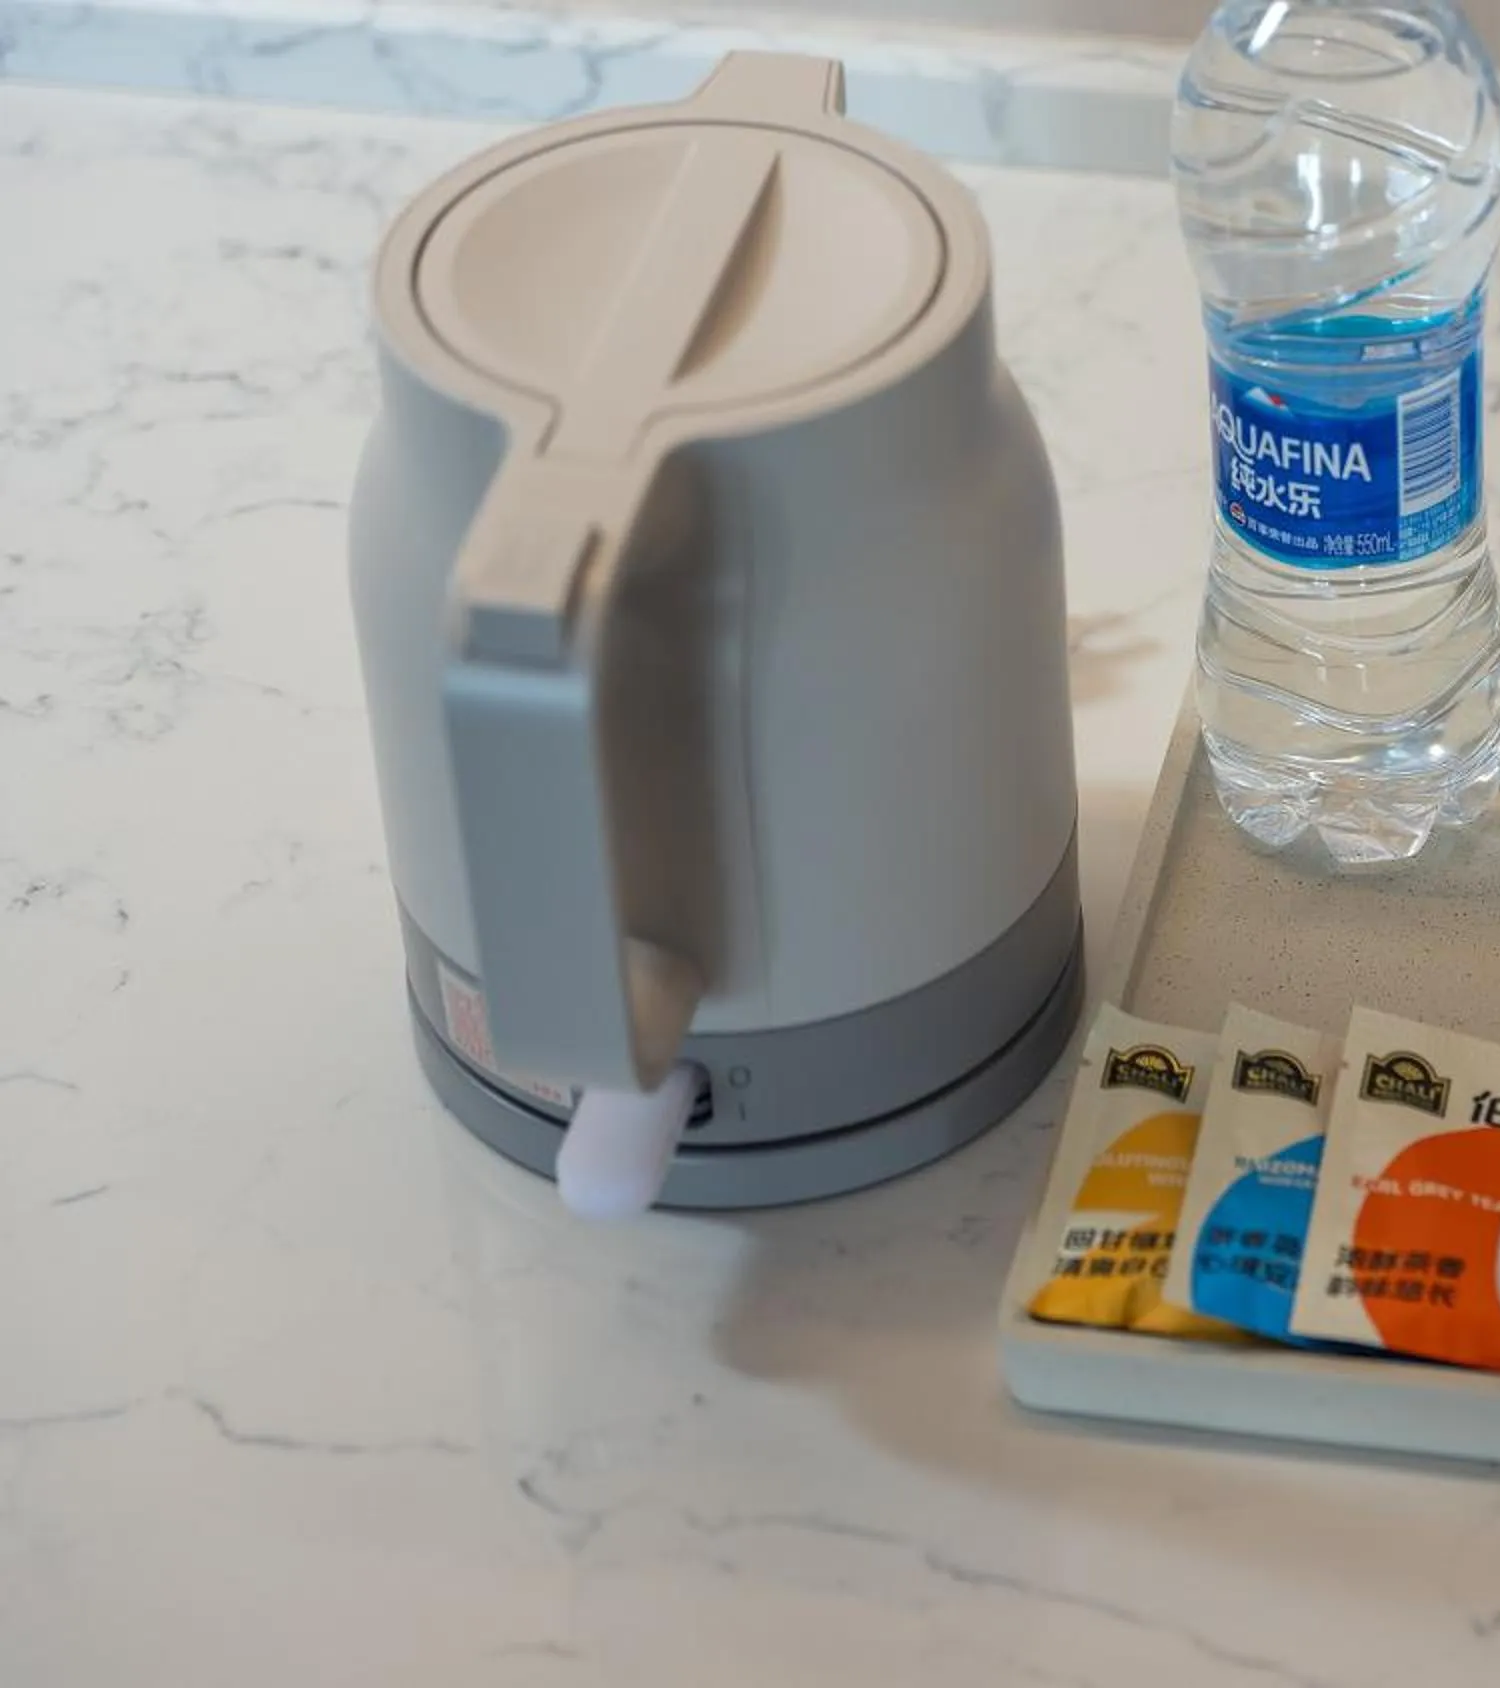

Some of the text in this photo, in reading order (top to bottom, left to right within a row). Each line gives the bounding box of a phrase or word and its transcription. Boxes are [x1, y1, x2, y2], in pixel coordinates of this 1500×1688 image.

[1231, 456, 1321, 519] 纯水乐
[1408, 1178, 1464, 1201] GREY
